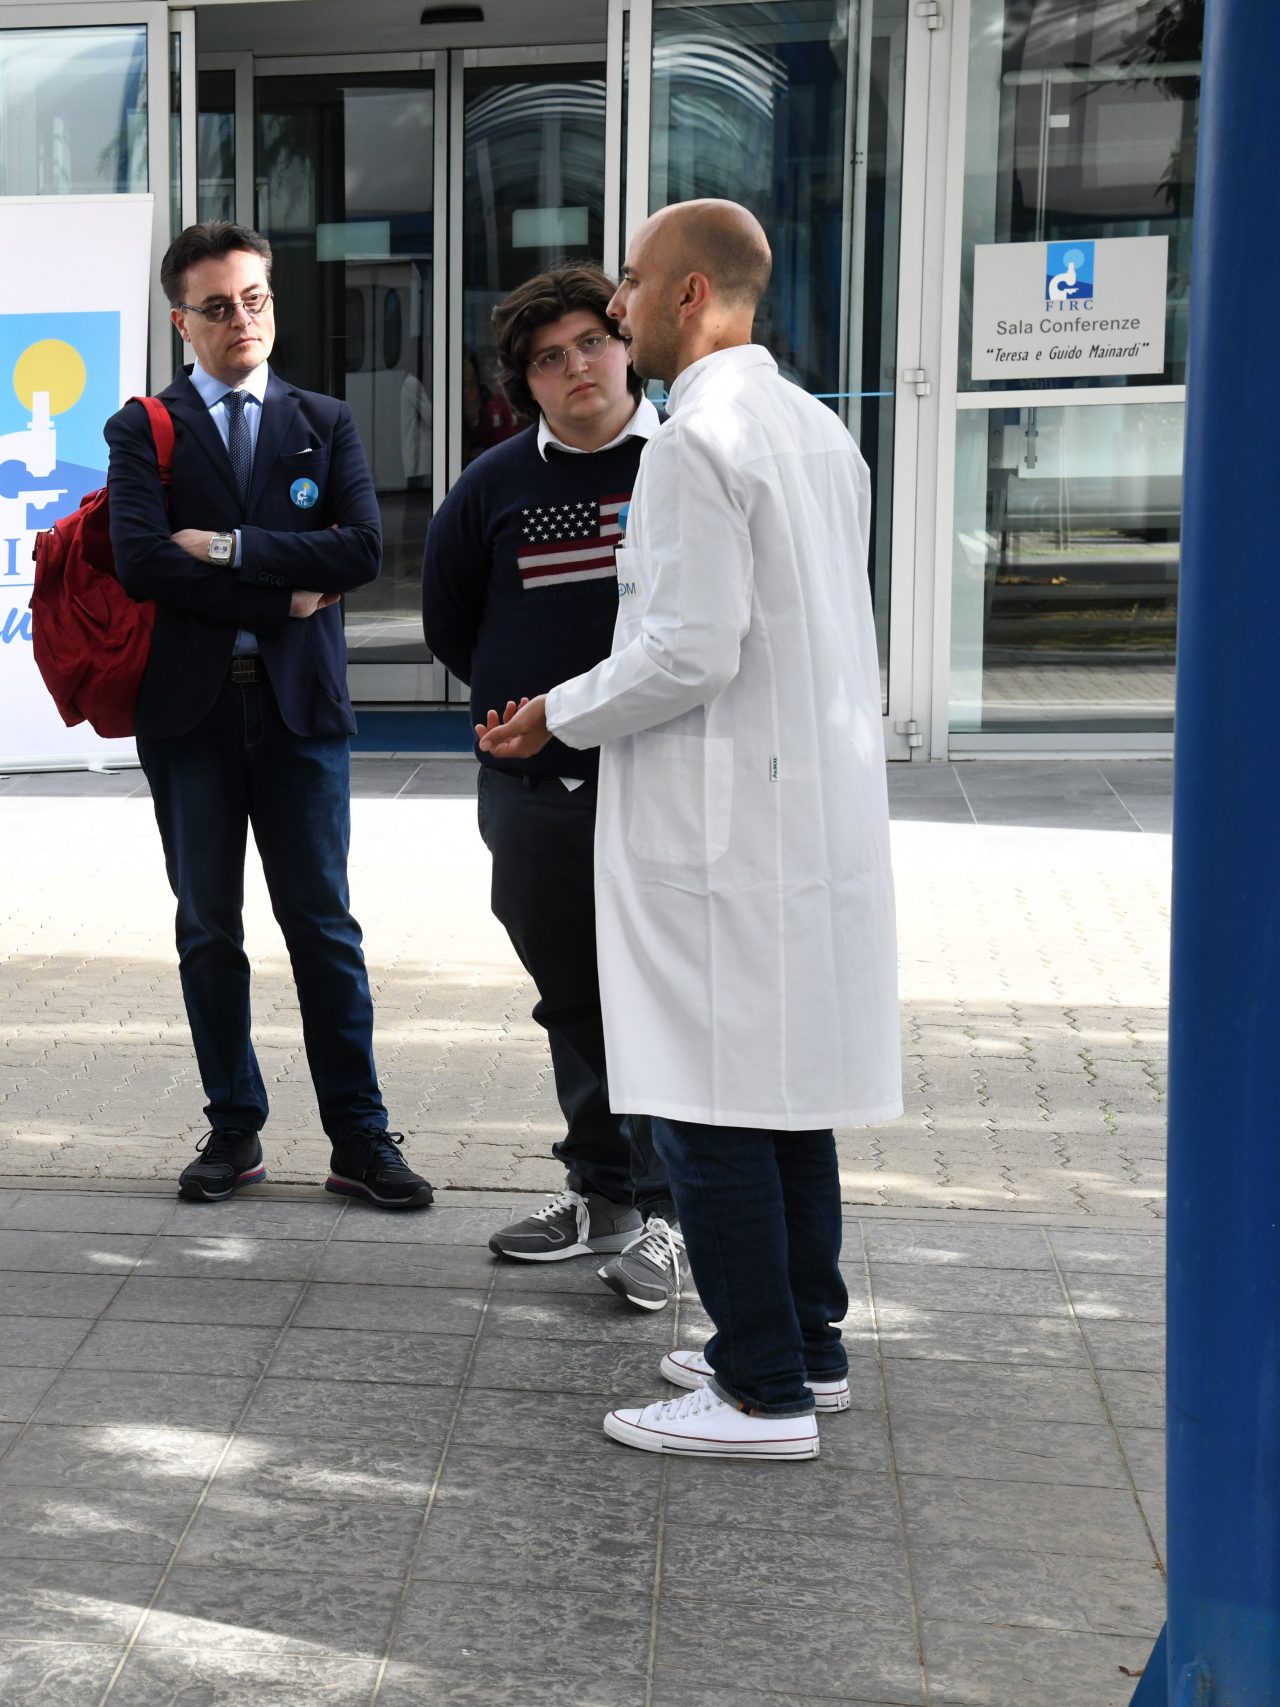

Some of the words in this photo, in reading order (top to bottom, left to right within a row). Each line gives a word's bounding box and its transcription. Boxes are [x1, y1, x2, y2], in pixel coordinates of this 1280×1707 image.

[1045, 299, 1094, 312] FIRC
[996, 320, 1033, 335] Sala
[1039, 317, 1141, 334] Conferenze
[1035, 351, 1042, 360] e
[1049, 345, 1082, 360] Guido
[618, 582, 636, 596] OM
